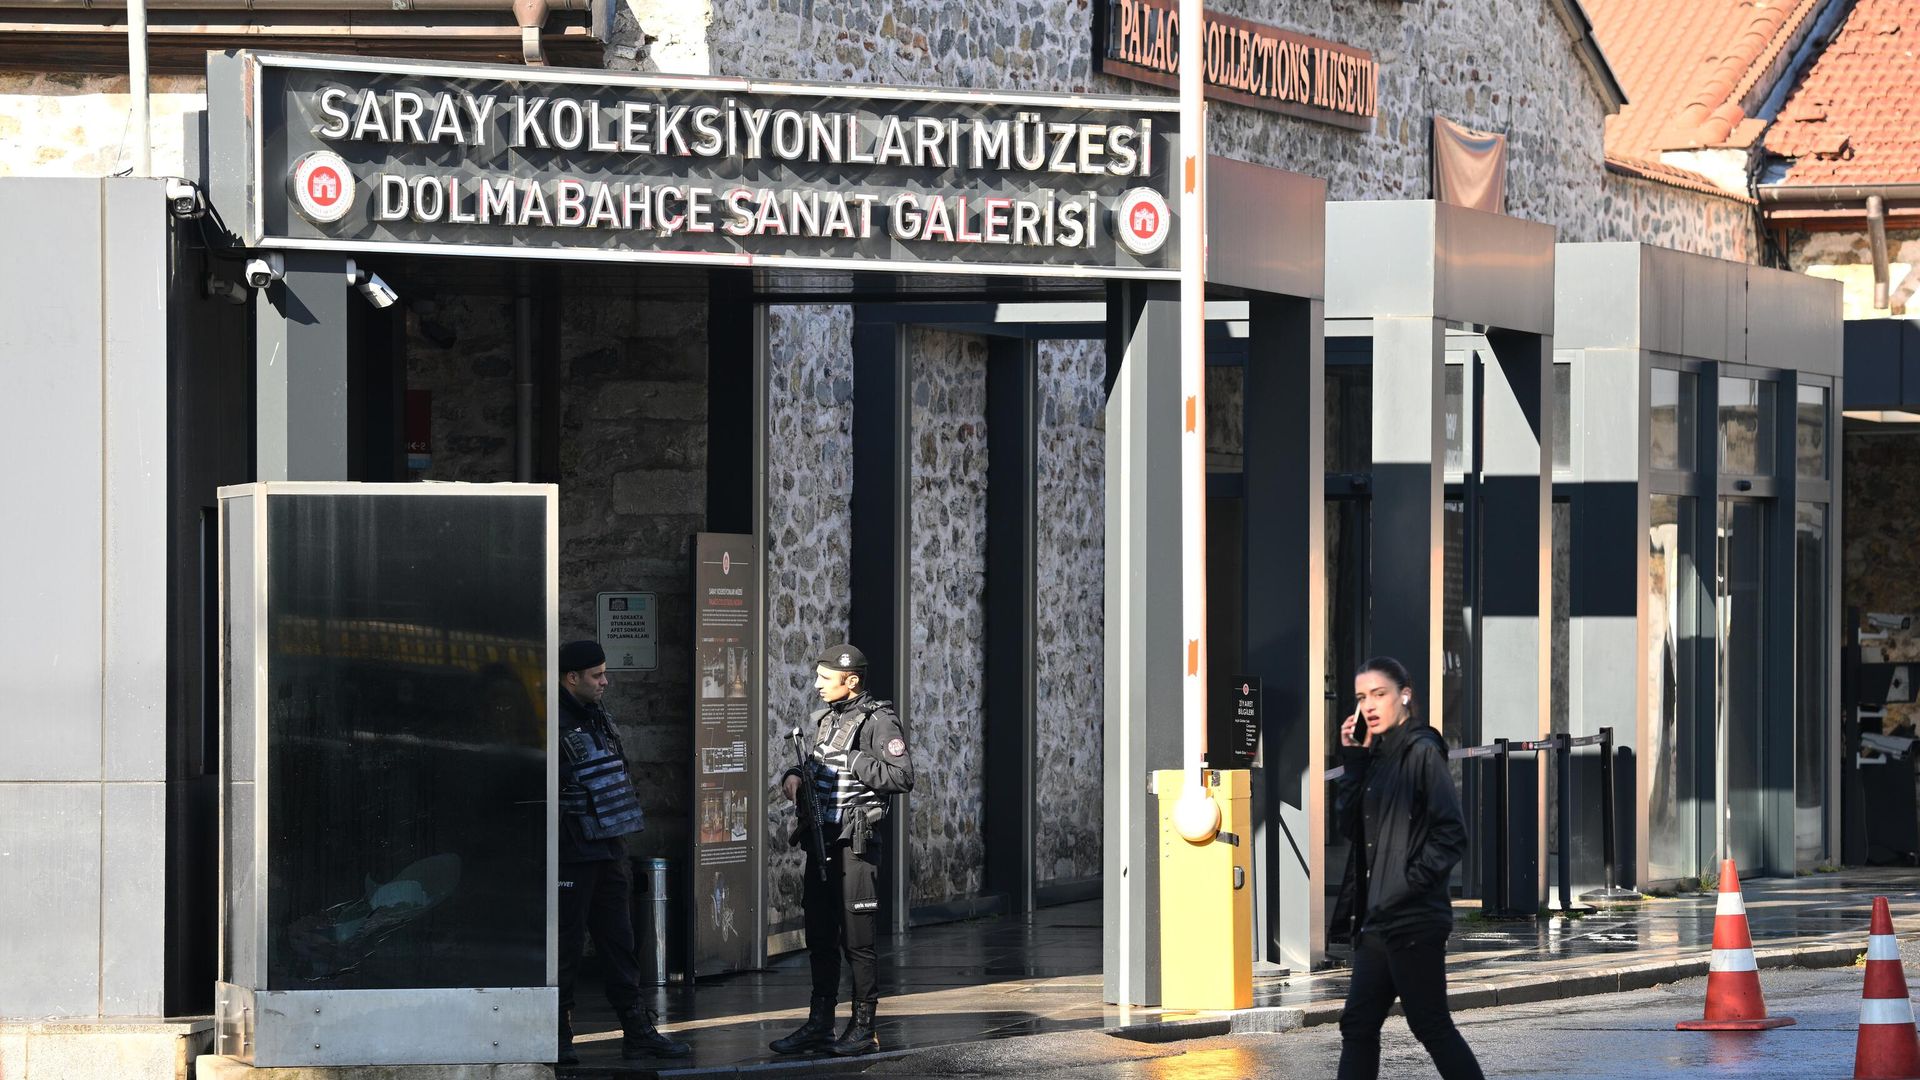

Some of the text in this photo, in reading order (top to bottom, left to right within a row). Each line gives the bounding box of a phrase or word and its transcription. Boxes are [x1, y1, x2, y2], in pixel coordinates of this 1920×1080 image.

[1119, 0, 1180, 74] PALAC
[1313, 47, 1379, 118] MUSEUM
[314, 87, 1152, 178] SARAY KOLEKSİYONLARI MÜZESİ
[375, 172, 714, 238] DOLMABAHÇE
[722, 188, 879, 239] SANAT
[891, 190, 1097, 248] GALERİSİ
